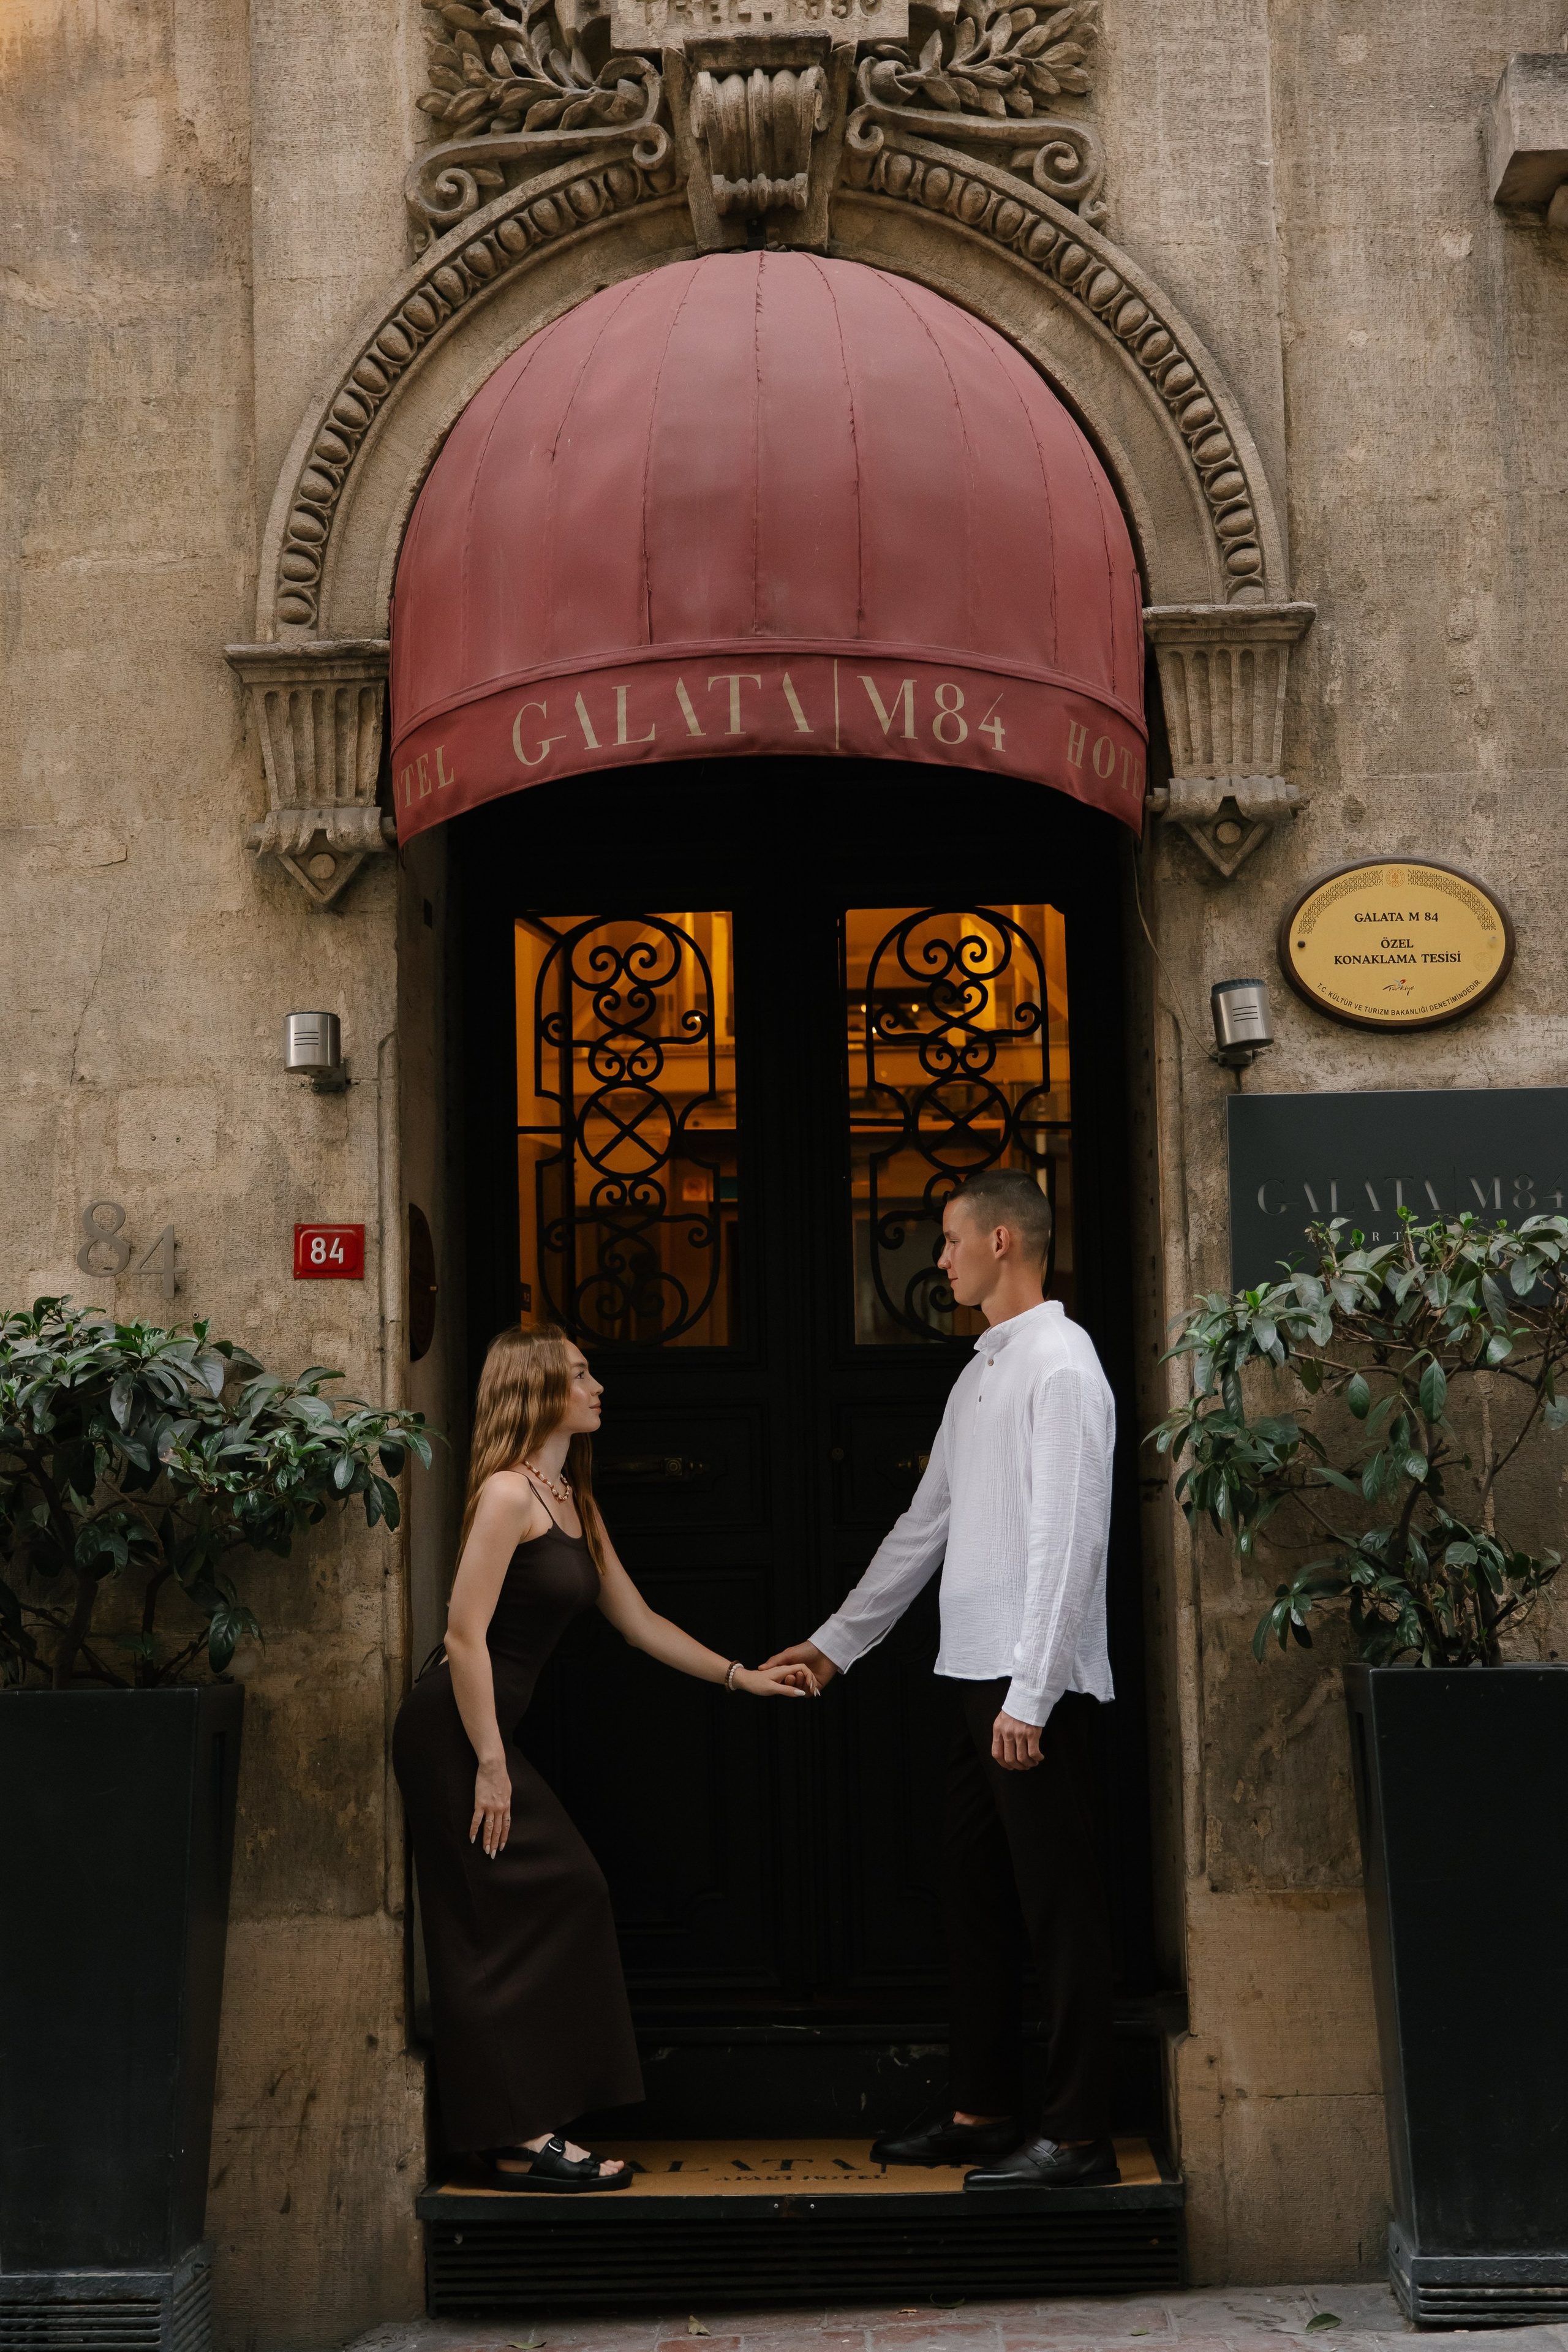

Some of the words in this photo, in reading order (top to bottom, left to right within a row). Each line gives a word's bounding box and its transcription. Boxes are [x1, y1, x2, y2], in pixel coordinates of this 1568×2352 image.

[397, 745, 454, 810] TEL
[512, 672, 815, 766] GALATA
[857, 675, 1006, 753] M84
[1354, 911, 1404, 922] GALATA
[1409, 911, 1420, 921] M
[1424, 912, 1439, 922] 84
[1334, 954, 1417, 965] KONAKLAMA
[1421, 951, 1461, 963] TESİSİ
[1381, 937, 1414, 949] ÖZEL
[1317, 982, 1327, 994] T.C.
[1328, 991, 1353, 1008] KÜLTÜR
[1354, 1003, 1363, 1011] VE
[1364, 1006, 1389, 1016] TURİZM
[1391, 1006, 1428, 1016] BAKANLIĞI
[1257, 1175, 1441, 1215] GALATA
[1466, 1173, 1566, 1210] M84
[77, 1200, 187, 1299] 84
[310, 1237, 344, 1264] 84
